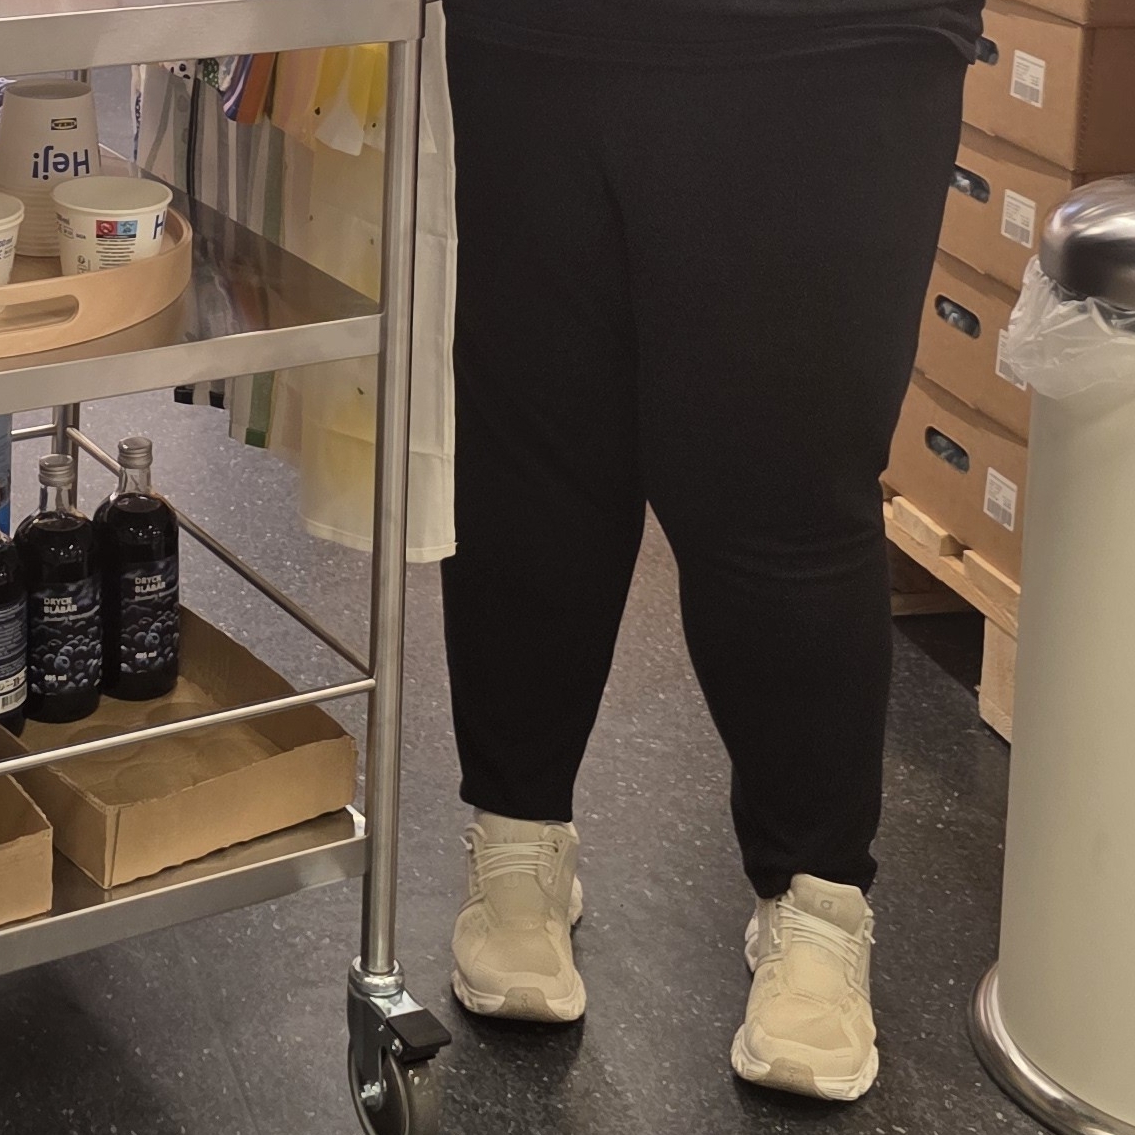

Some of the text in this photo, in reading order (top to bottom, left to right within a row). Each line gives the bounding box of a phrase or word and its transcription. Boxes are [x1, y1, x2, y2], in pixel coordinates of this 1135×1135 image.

[31, 145, 91, 181] Hej!
[135, 574, 162, 585] DRYCK
[43, 597, 73, 606] DRYCK
